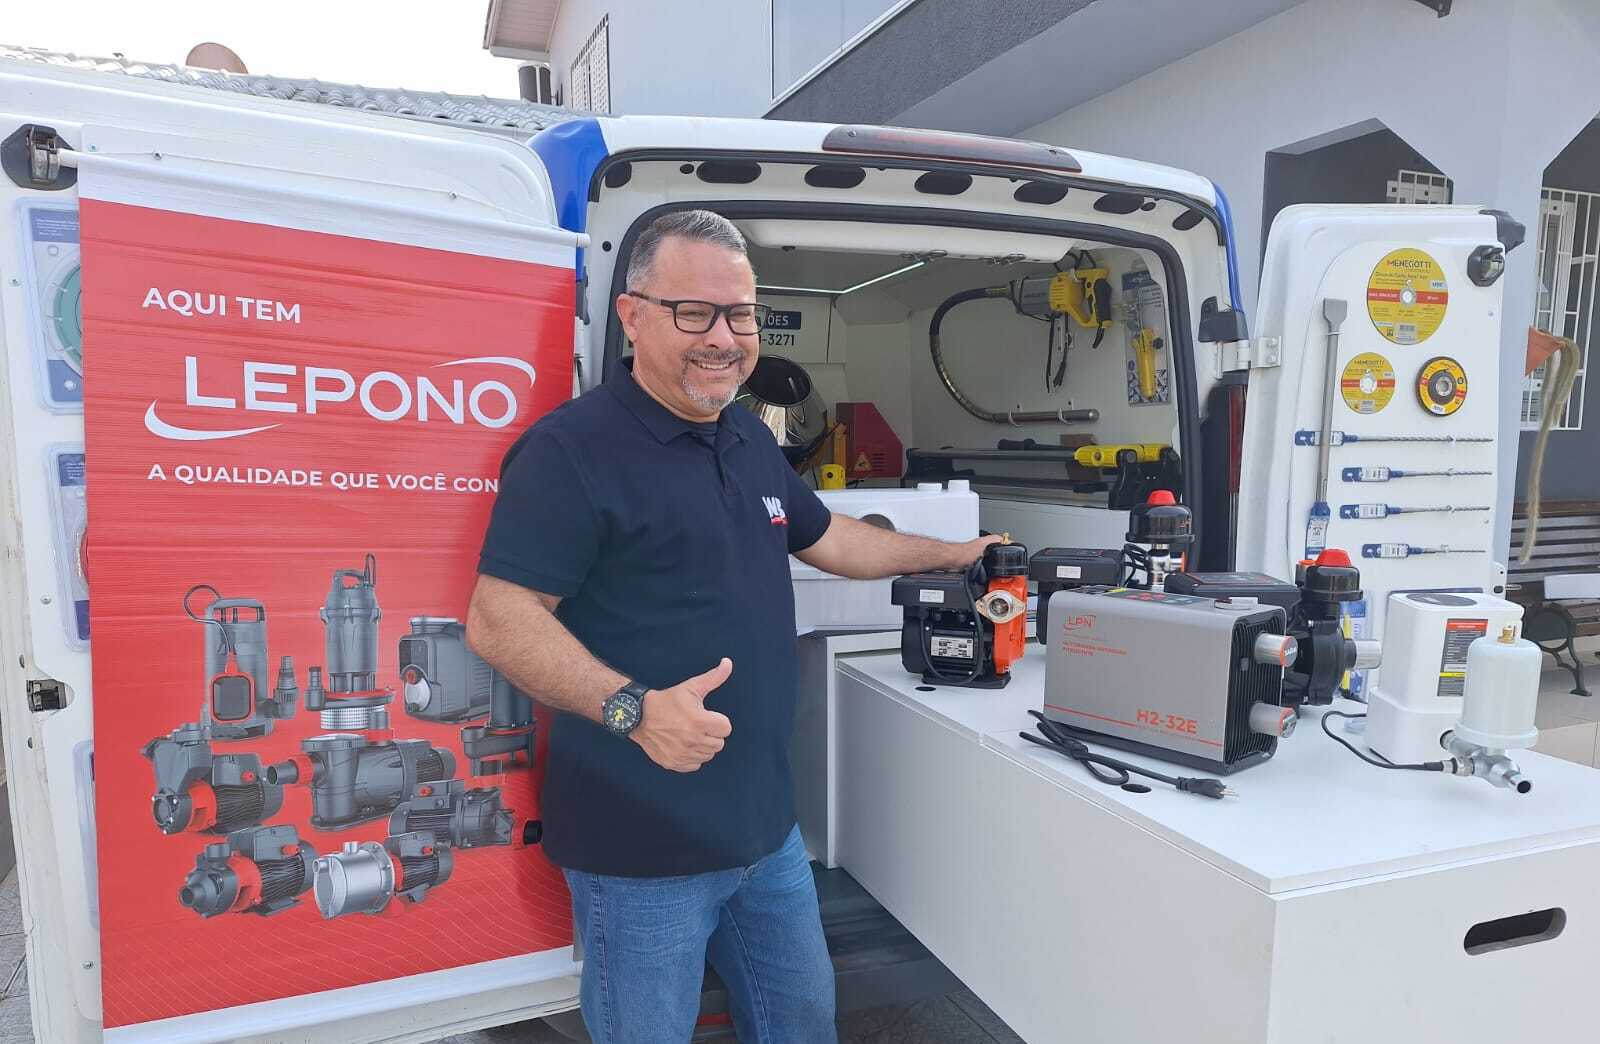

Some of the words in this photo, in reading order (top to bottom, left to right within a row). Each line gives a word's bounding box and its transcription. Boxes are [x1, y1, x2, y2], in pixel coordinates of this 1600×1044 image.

[1387, 258, 1432, 269] MENEGOTTI
[142, 287, 226, 317] AQUI
[235, 296, 301, 324] TEM
[767, 312, 789, 326] ÕES
[759, 333, 795, 346] -3271
[185, 355, 518, 429] LEPONO
[147, 463, 167, 481] A
[174, 465, 323, 486] QUALIDADE
[330, 471, 379, 490] QUE
[385, 472, 447, 491] VOCÊ
[453, 478, 499, 493] CON
[1136, 708, 1197, 735] H2-32E
